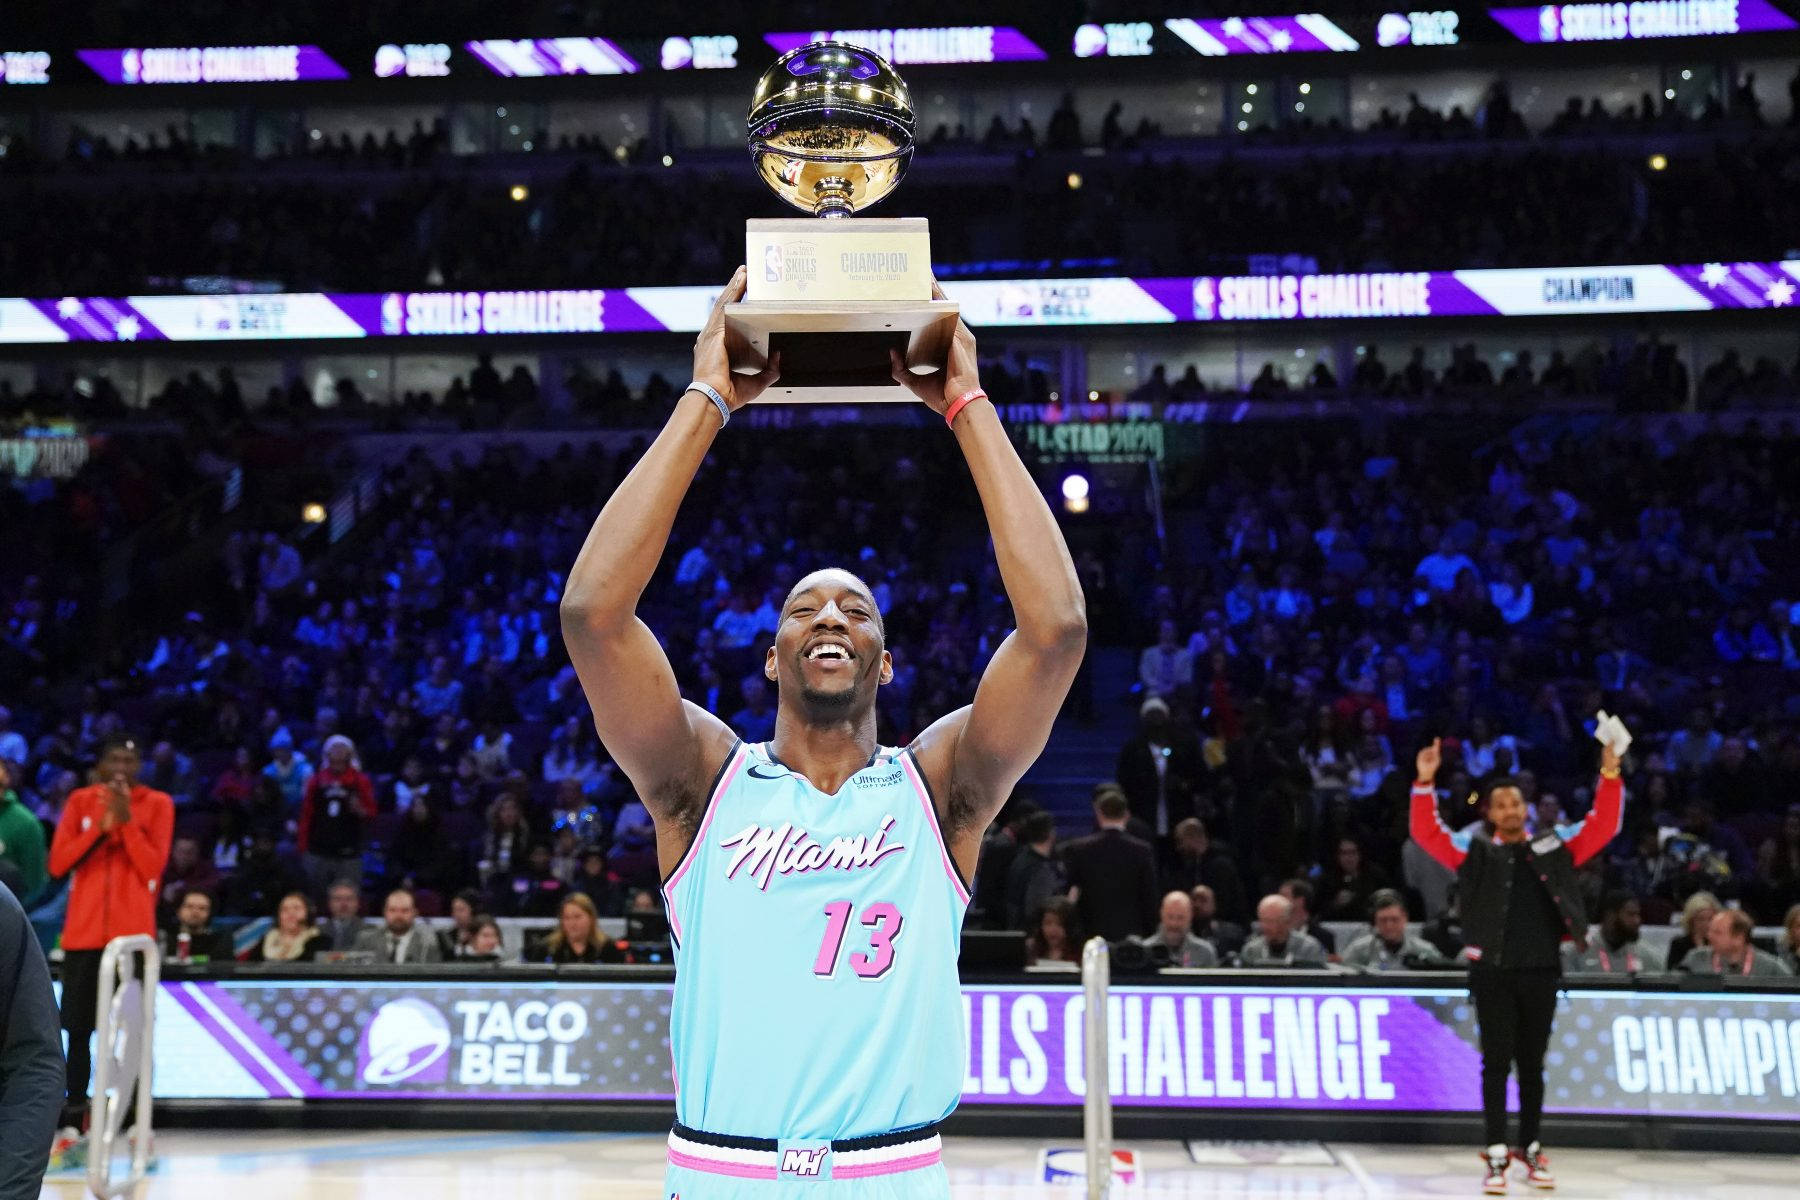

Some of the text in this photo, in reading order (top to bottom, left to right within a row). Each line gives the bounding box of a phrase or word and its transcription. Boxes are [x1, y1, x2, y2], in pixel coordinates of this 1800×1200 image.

[785, 258, 816, 273] SKILLS
[841, 252, 908, 273] CHAMPION
[1218, 272, 1431, 319] SKILLS CHALLENGE
[1544, 277, 1634, 302] CHAMPION
[406, 290, 605, 334] SKILLS CHALLENGE
[852, 771, 902, 785] Ultimate
[720, 814, 905, 893] Miami
[814, 900, 903, 982] 13
[455, 1000, 588, 1043] TACO
[459, 1043, 582, 1085] BELL
